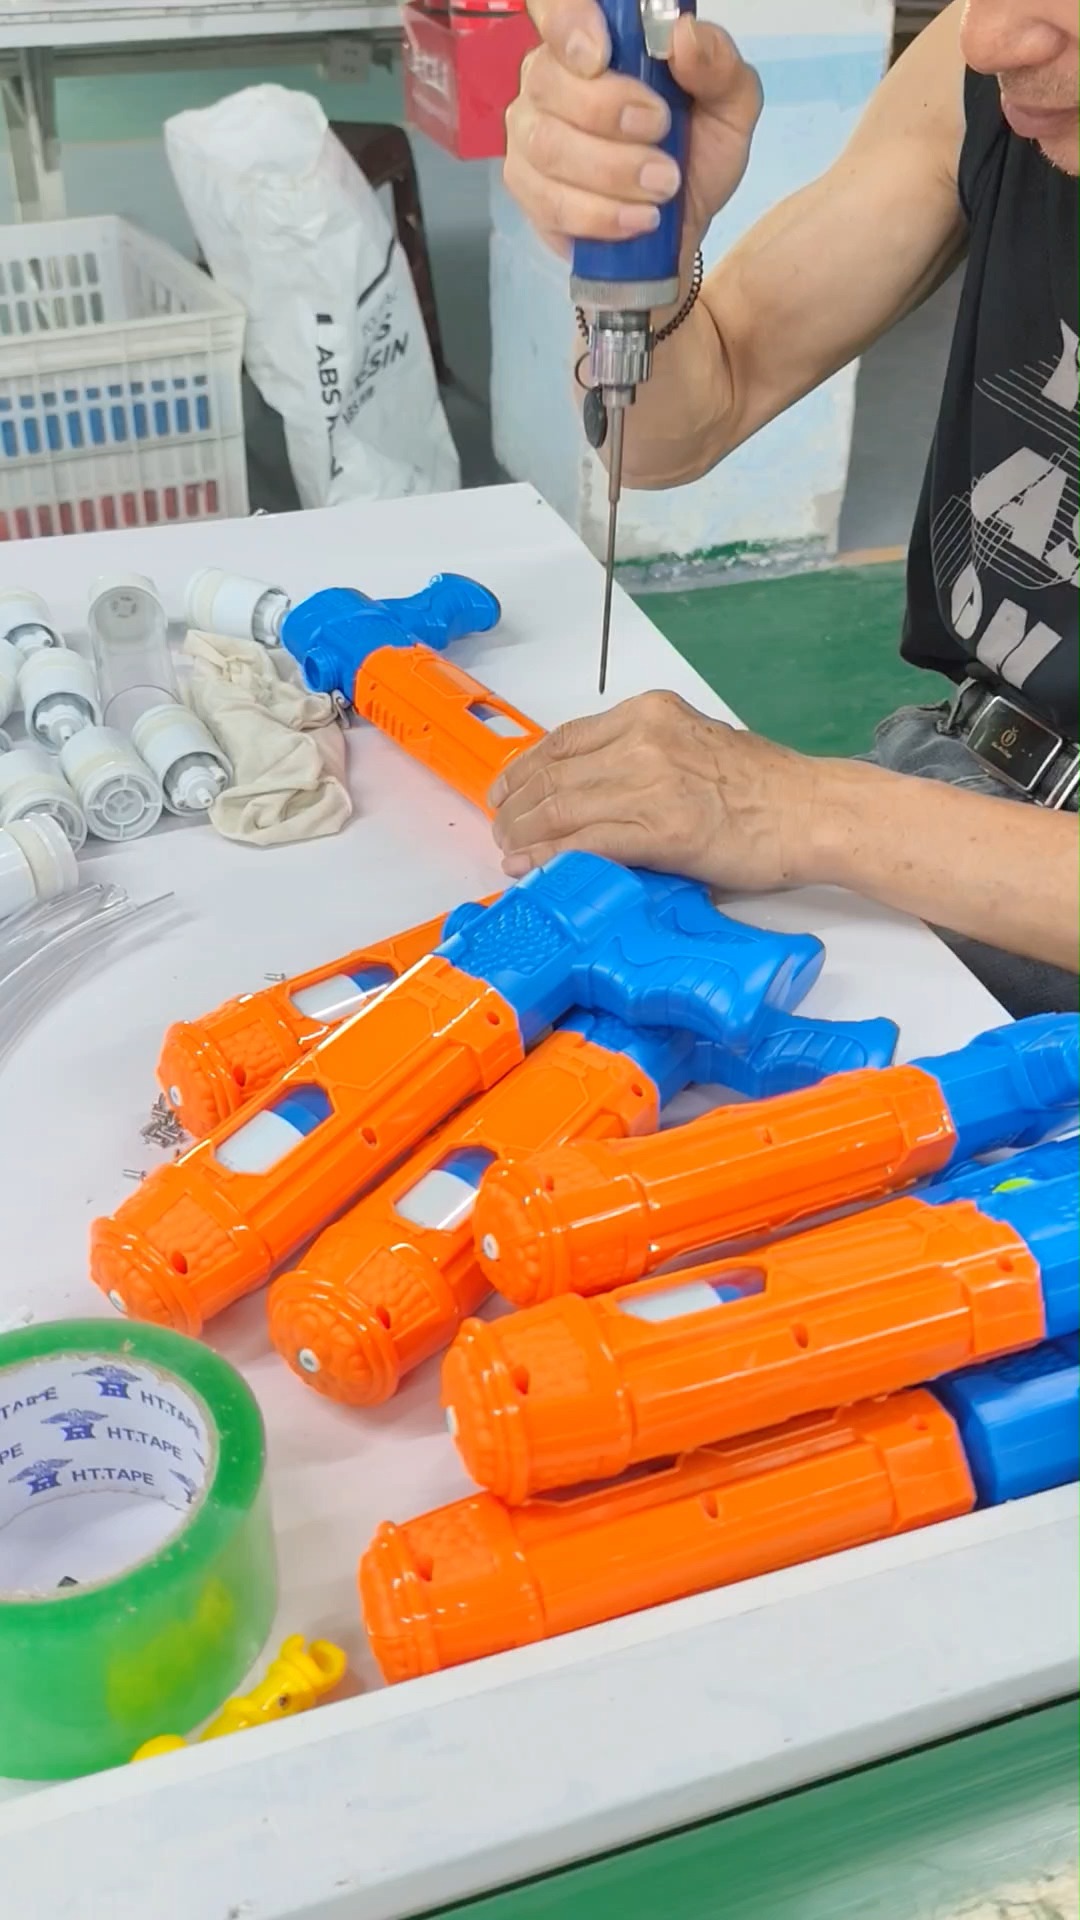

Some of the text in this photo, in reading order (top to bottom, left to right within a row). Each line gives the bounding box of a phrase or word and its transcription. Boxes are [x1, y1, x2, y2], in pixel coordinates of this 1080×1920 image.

[316, 345, 342, 405] ABS
[107, 1426, 183, 1461] HT.TAPE
[71, 1467, 155, 1486] HT.TAPE
